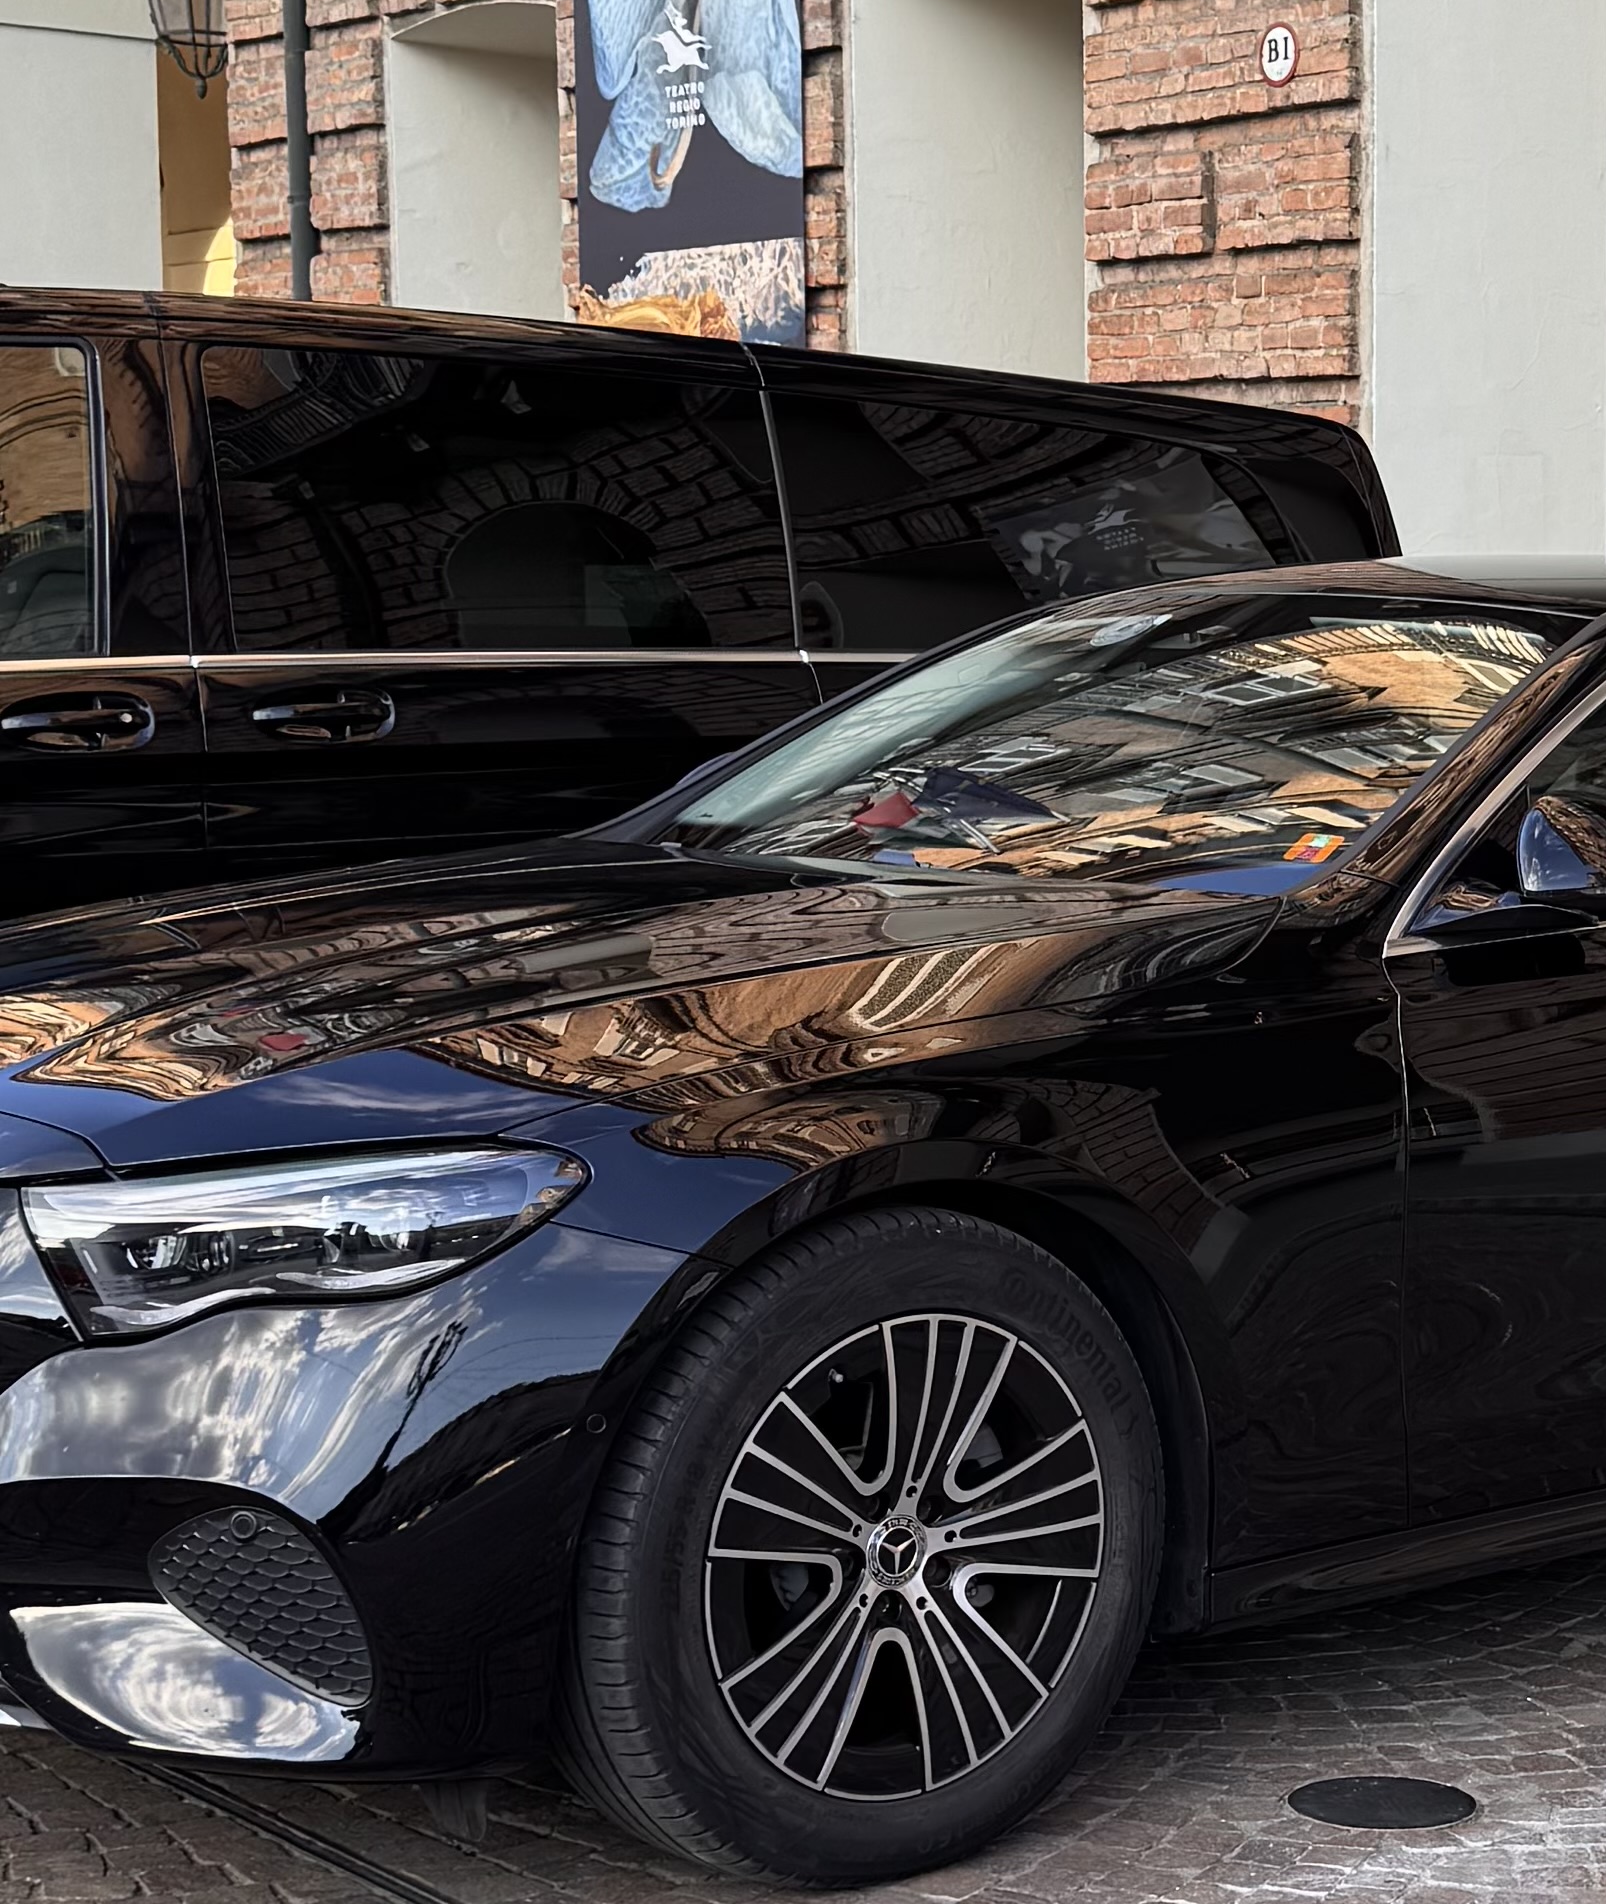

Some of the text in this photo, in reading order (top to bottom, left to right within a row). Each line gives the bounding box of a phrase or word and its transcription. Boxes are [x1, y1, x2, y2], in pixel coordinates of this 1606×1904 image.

[665, 81, 705, 98] TEATRO
[669, 97, 701, 113] REGIO
[665, 112, 706, 130] TORINO
